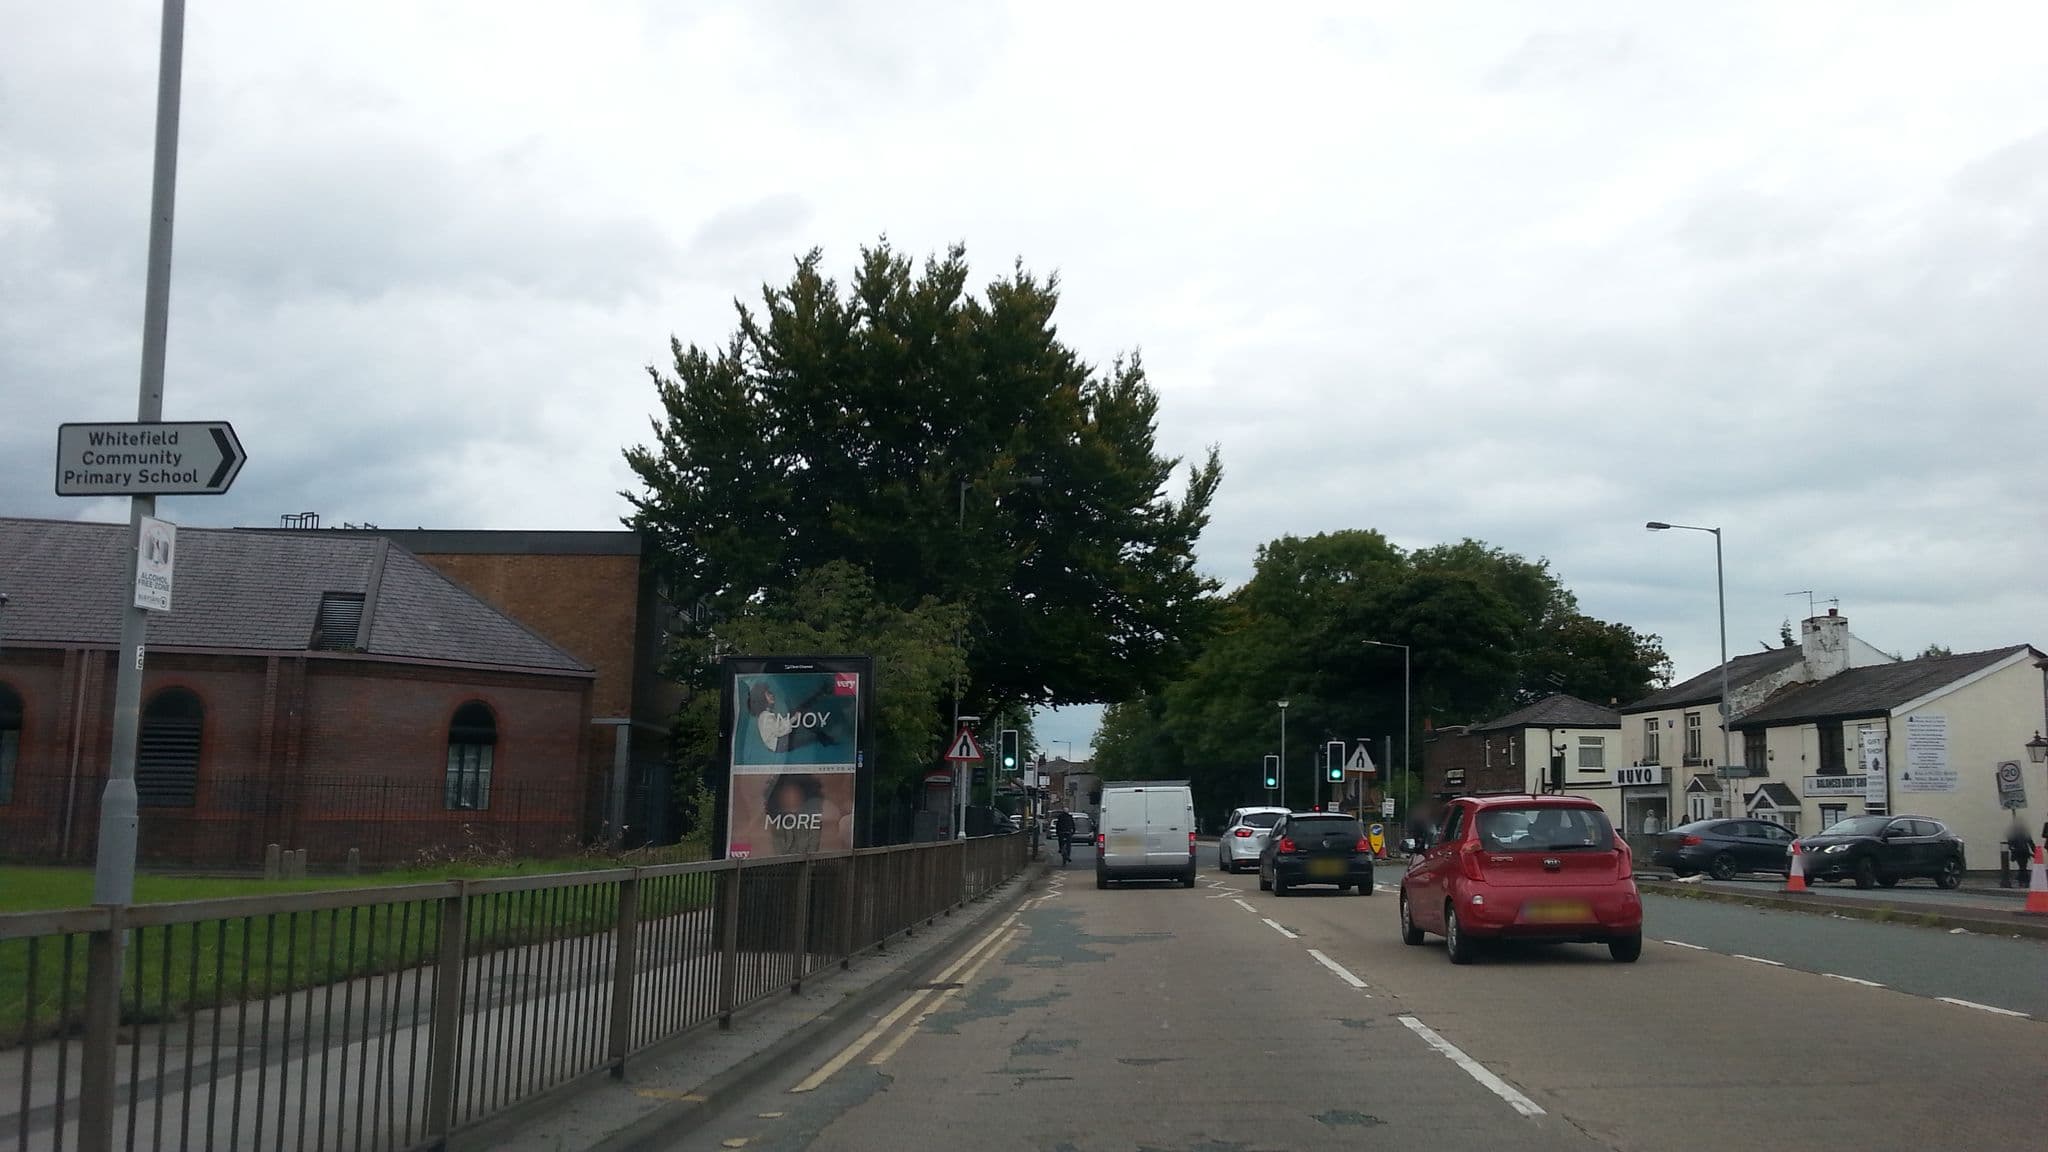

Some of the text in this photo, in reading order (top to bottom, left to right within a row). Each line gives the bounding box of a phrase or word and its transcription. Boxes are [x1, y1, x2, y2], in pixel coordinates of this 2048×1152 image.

[89, 431, 178, 446] Whitefield
[82, 450, 182, 467] Community
[64, 468, 198, 486] Primary School
[141, 572, 168, 584] ALCOHOL
[836, 680, 856, 689] very
[1617, 768, 1652, 784] NUVO
[2003, 768, 2017, 778] 20
[764, 813, 823, 831] MORE
